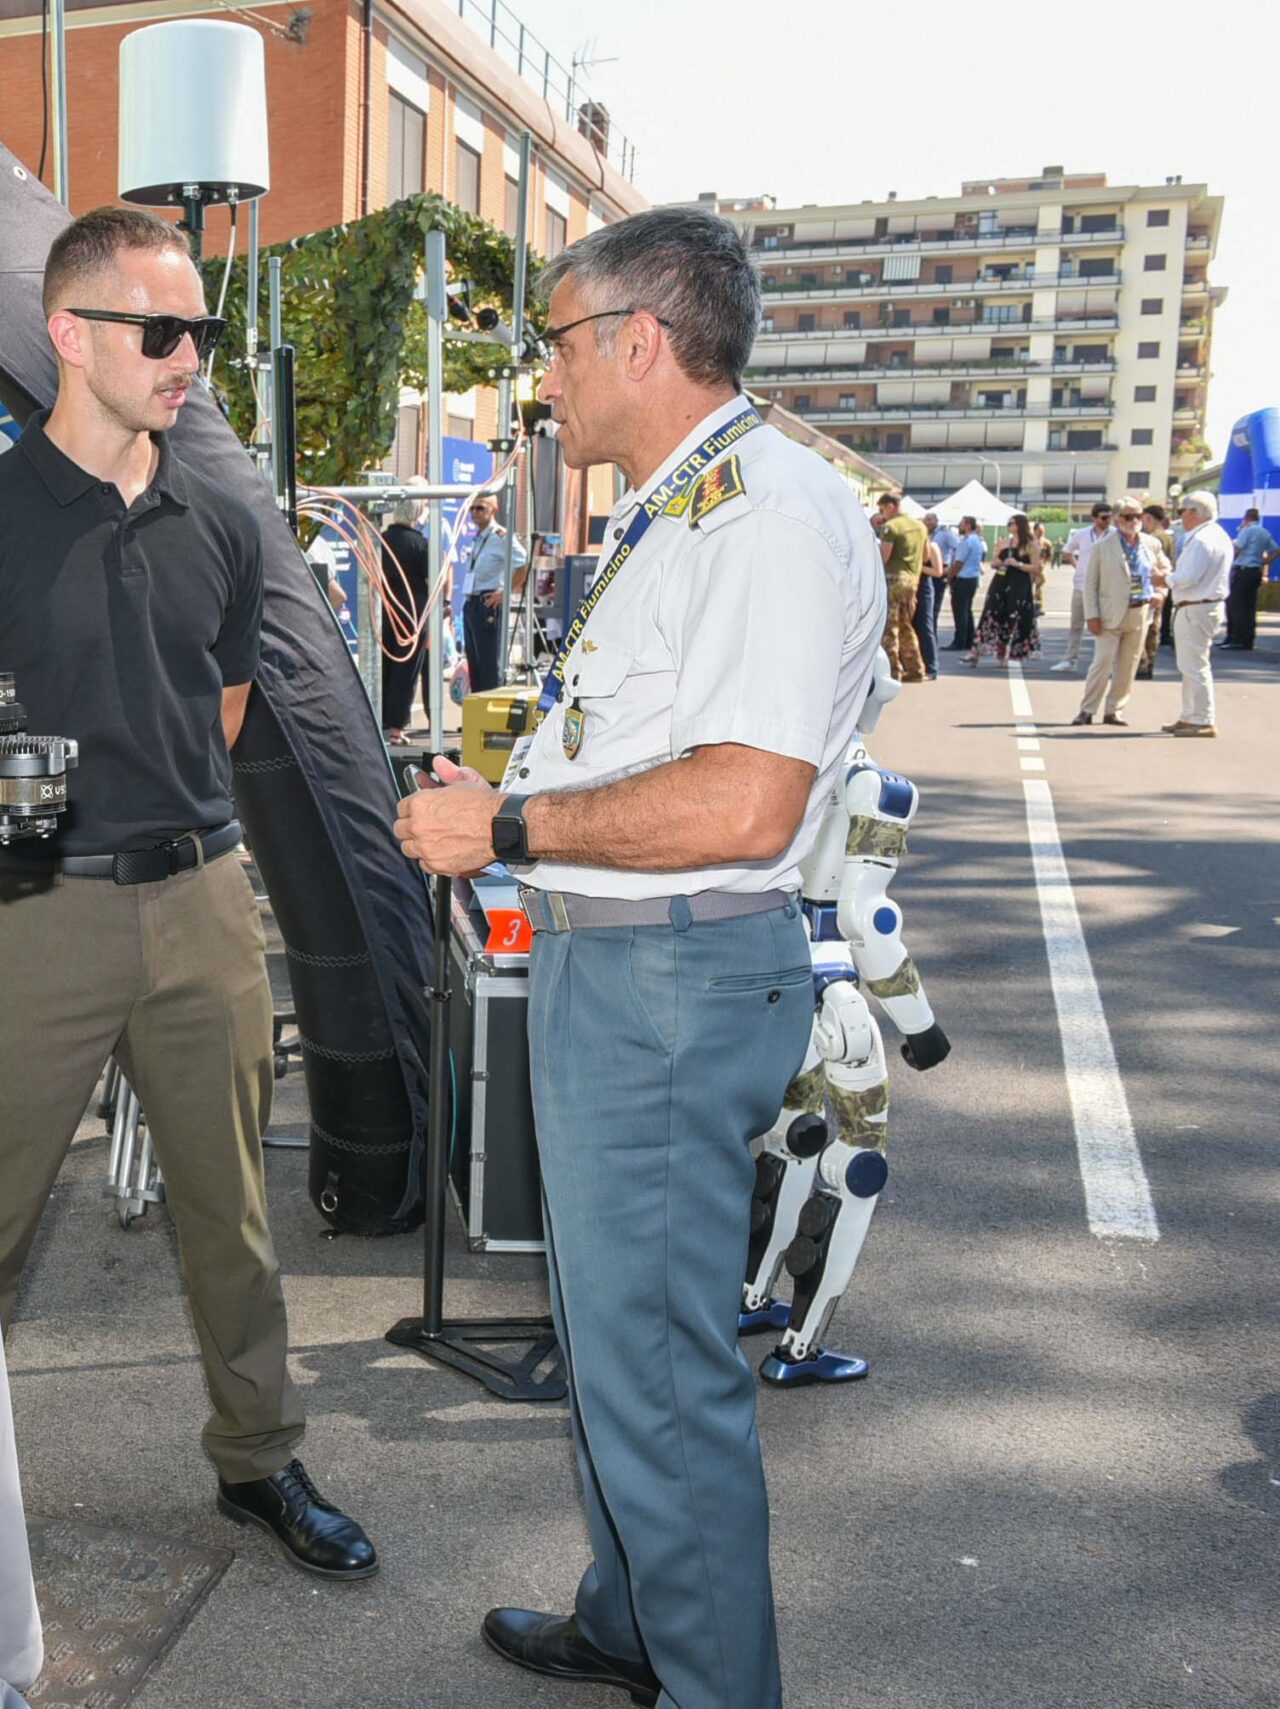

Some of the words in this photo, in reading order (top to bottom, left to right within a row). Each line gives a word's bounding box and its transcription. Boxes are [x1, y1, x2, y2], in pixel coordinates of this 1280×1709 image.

[643, 453, 707, 519] AM-CTR
[552, 619, 584, 682] AM-CTR
[579, 543, 631, 619] Fiumicino
[502, 919, 523, 946] 3
